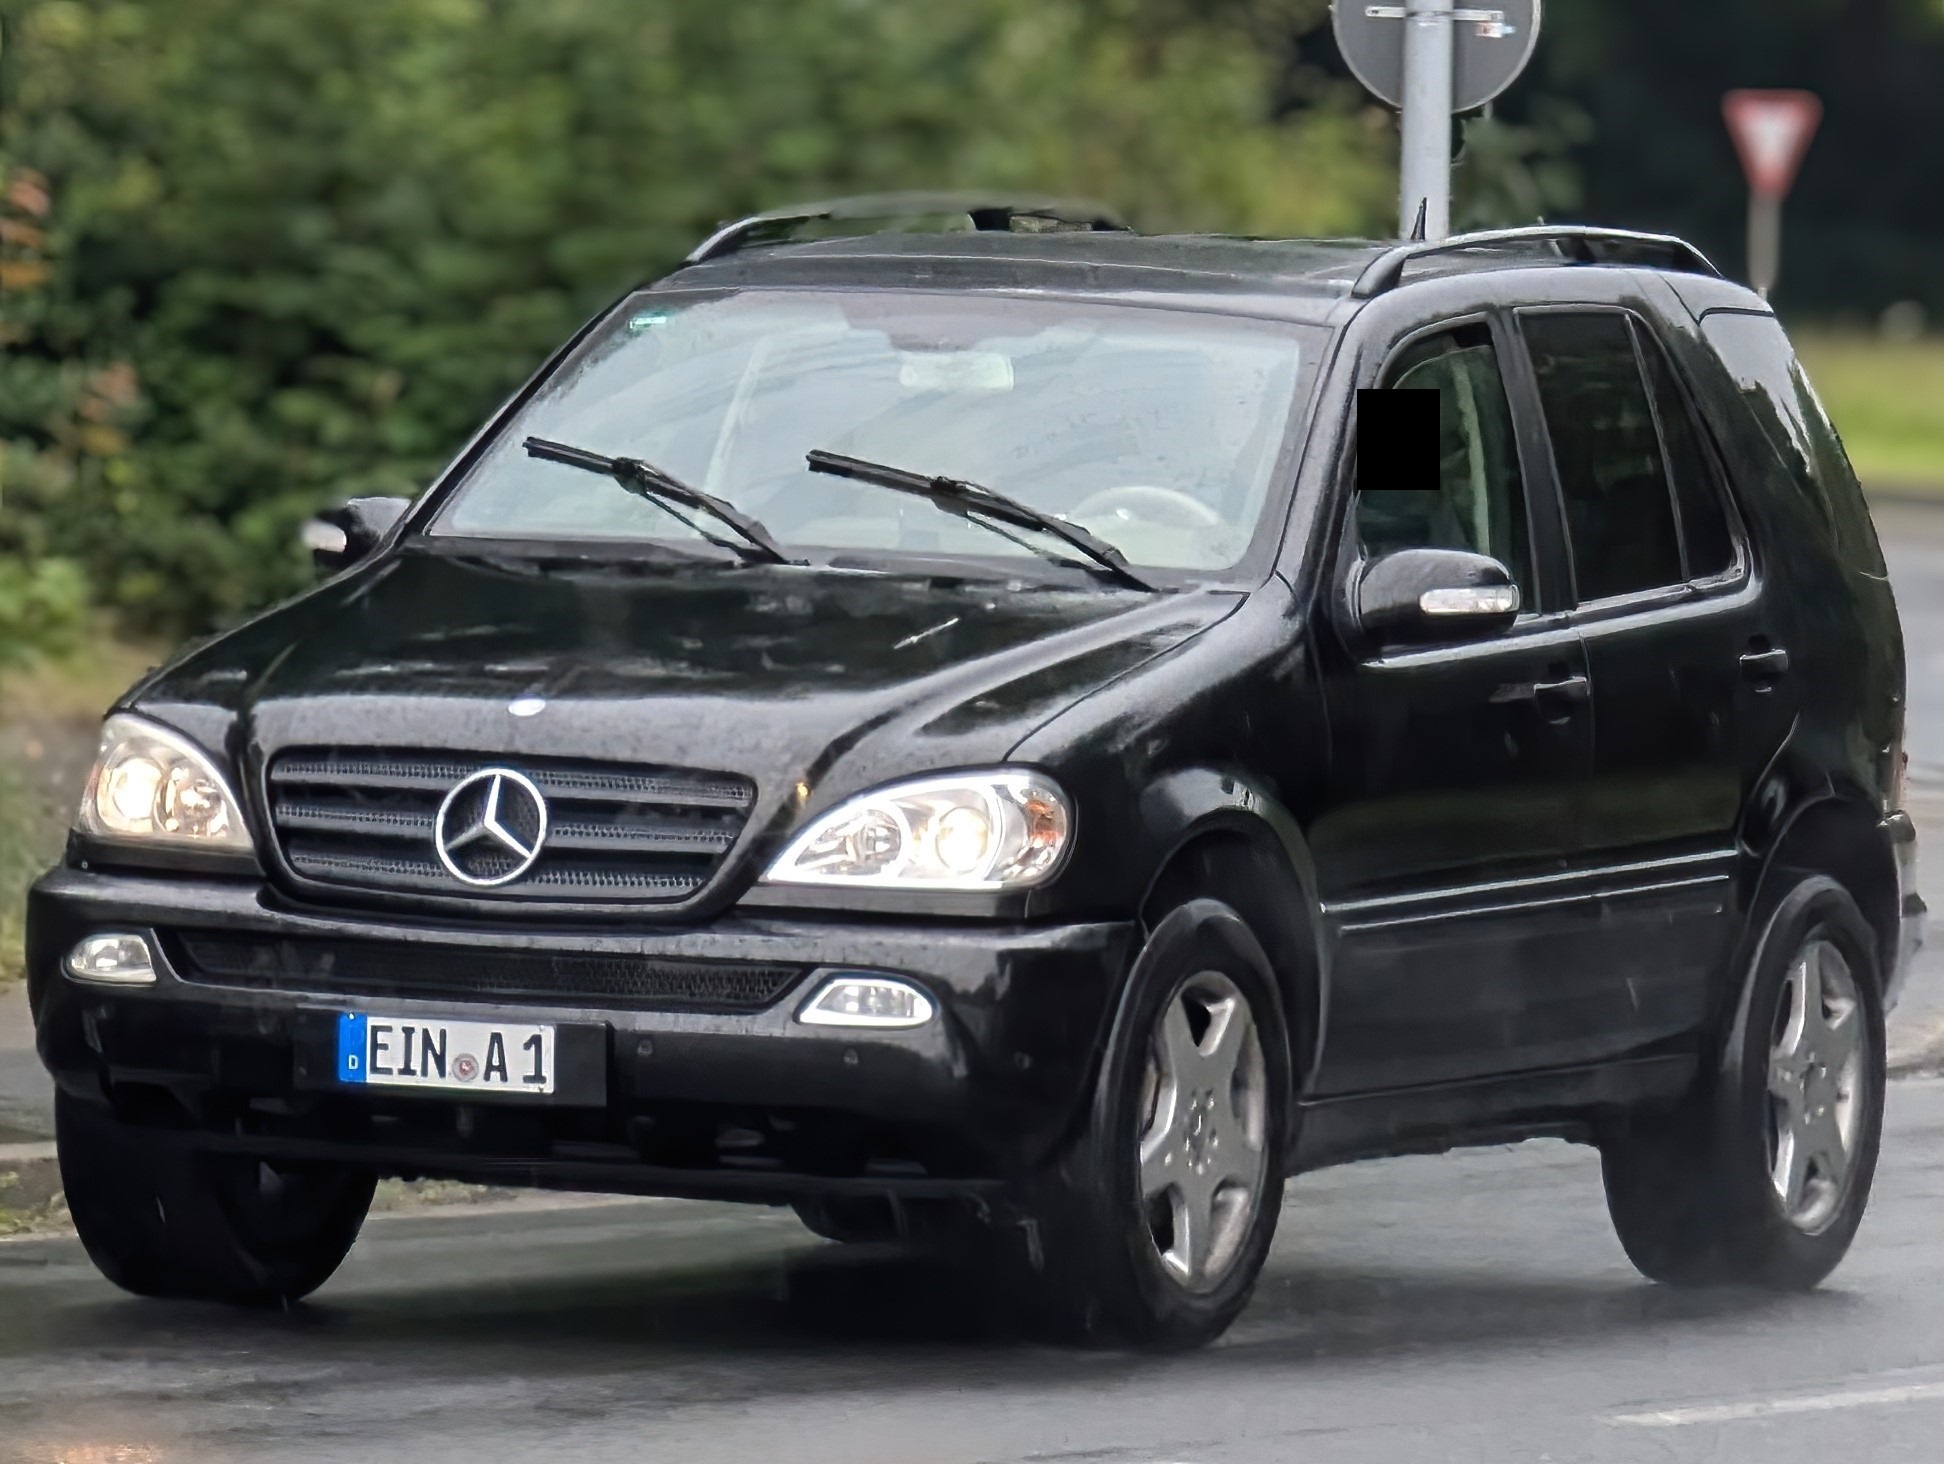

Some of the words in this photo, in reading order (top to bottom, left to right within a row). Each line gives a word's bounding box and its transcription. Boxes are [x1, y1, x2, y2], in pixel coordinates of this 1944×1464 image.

[348, 1054, 359, 1070] D
[370, 1025, 447, 1078] EIN
[483, 1032, 508, 1082] A
[523, 1034, 547, 1084] 1
